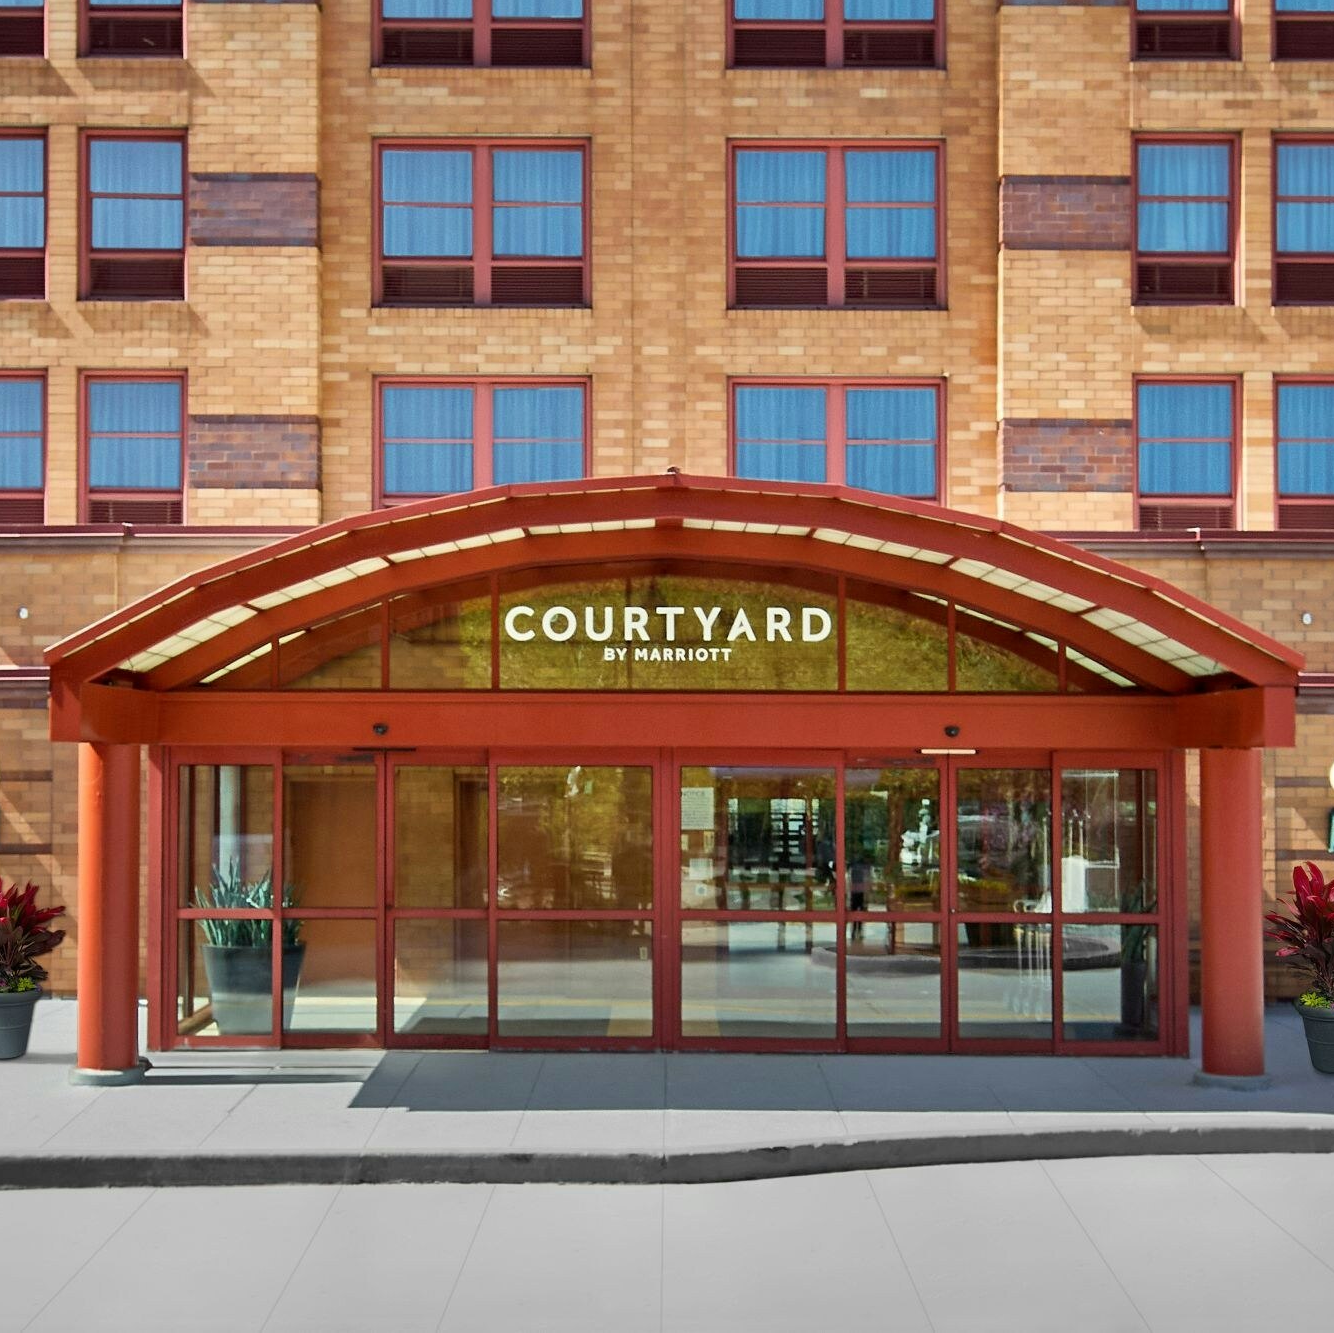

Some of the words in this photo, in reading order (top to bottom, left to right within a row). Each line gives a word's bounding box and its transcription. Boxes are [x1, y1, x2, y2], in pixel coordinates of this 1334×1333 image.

[504, 606, 832, 642] COURTYARD
[604, 648, 628, 661] BY
[635, 648, 732, 662] MARRIOTT
